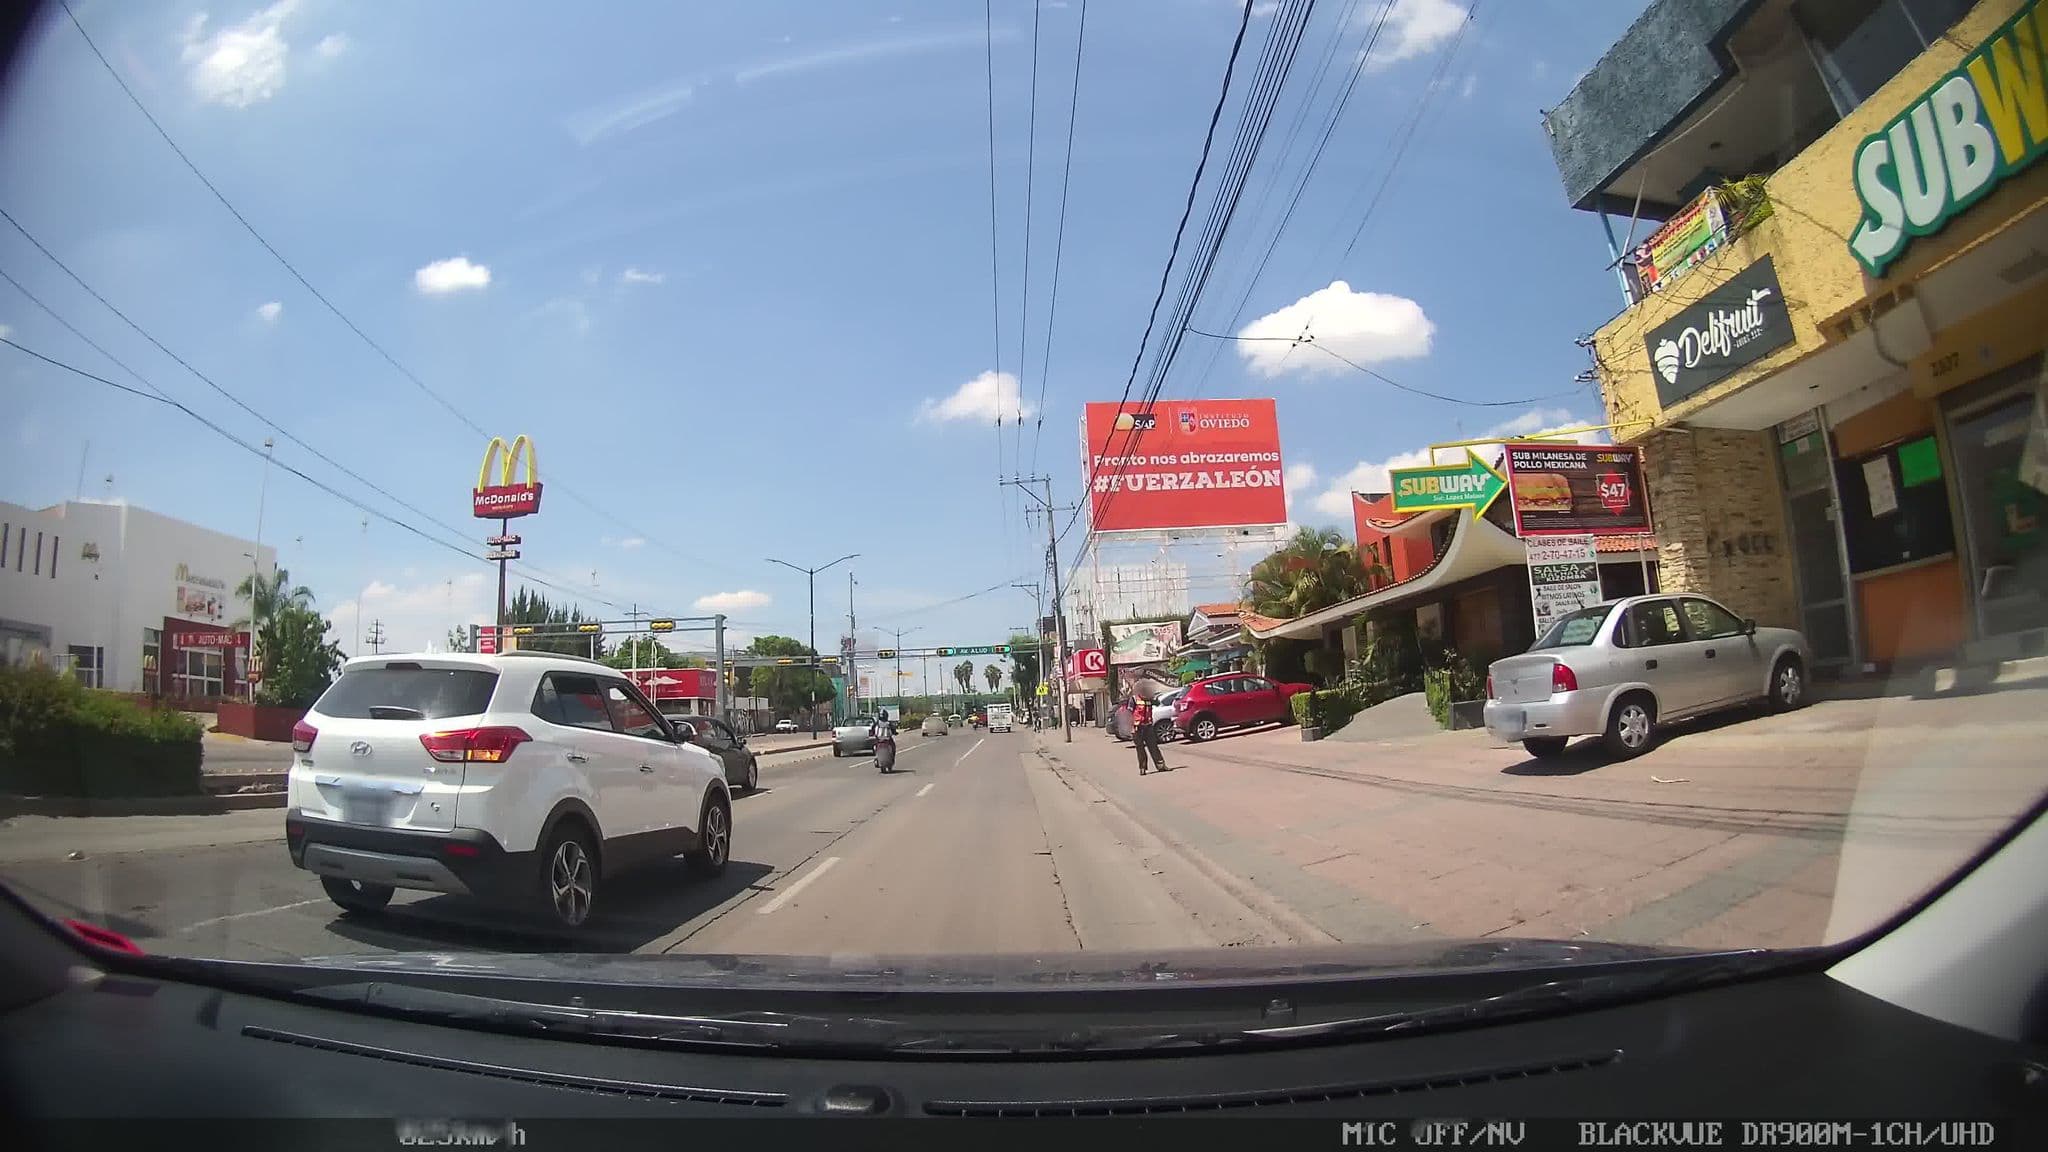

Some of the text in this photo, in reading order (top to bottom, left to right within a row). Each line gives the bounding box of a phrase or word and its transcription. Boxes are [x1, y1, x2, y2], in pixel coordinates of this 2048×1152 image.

[1852, 0, 2048, 267] SUBW
[1678, 288, 1771, 368] Delifruit
[1134, 419, 1155, 430] SAP
[1200, 418, 1250, 429] OVIEDO
[1094, 451, 1279, 467] Pronto nos abrazaremos
[1512, 452, 1530, 460] SUB
[1532, 452, 1574, 460] MILANESA
[1597, 453, 1633, 463] SUBWAY
[1514, 461, 1587, 469] POLLO MEXICANA
[1094, 465, 1280, 492] #FUERZALEÓN
[1398, 472, 1491, 498] SUBWAY
[1600, 483, 1626, 498] $47
[475, 491, 534, 506] McDonald's
[1534, 563, 1579, 574] SALSA
